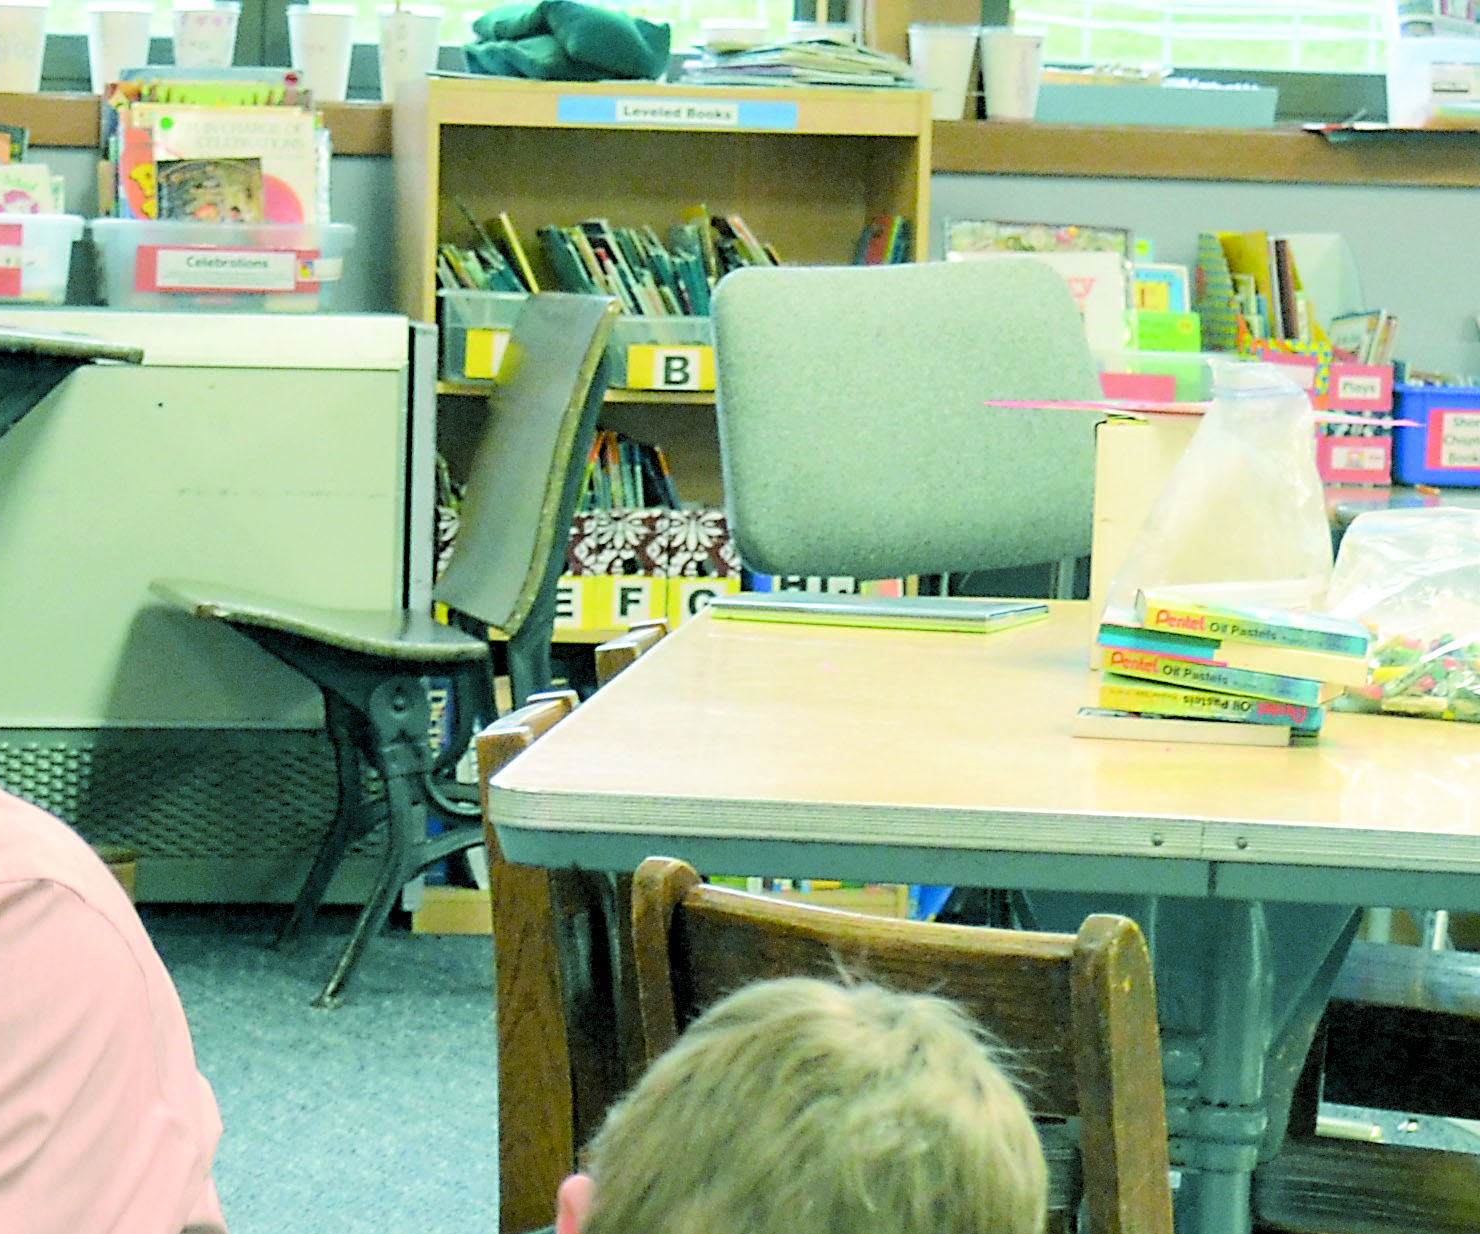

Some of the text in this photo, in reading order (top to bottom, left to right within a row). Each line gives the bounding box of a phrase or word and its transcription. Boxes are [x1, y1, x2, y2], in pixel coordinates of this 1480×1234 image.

[624, 105, 732, 120] Leveled Books
[186, 255, 269, 269] Celebrations
[664, 356, 690, 385] B
[1342, 381, 1377, 397] Plays
[621, 587, 642, 617] F
[1156, 609, 1277, 641] Pentel Oil Pastels
[1111, 651, 1229, 686] Pentel Oil Pastels
[1183, 694, 1229, 710] Pastels
[1232, 699, 1250, 712] Oil
[1255, 701, 1307, 723] Pentel
